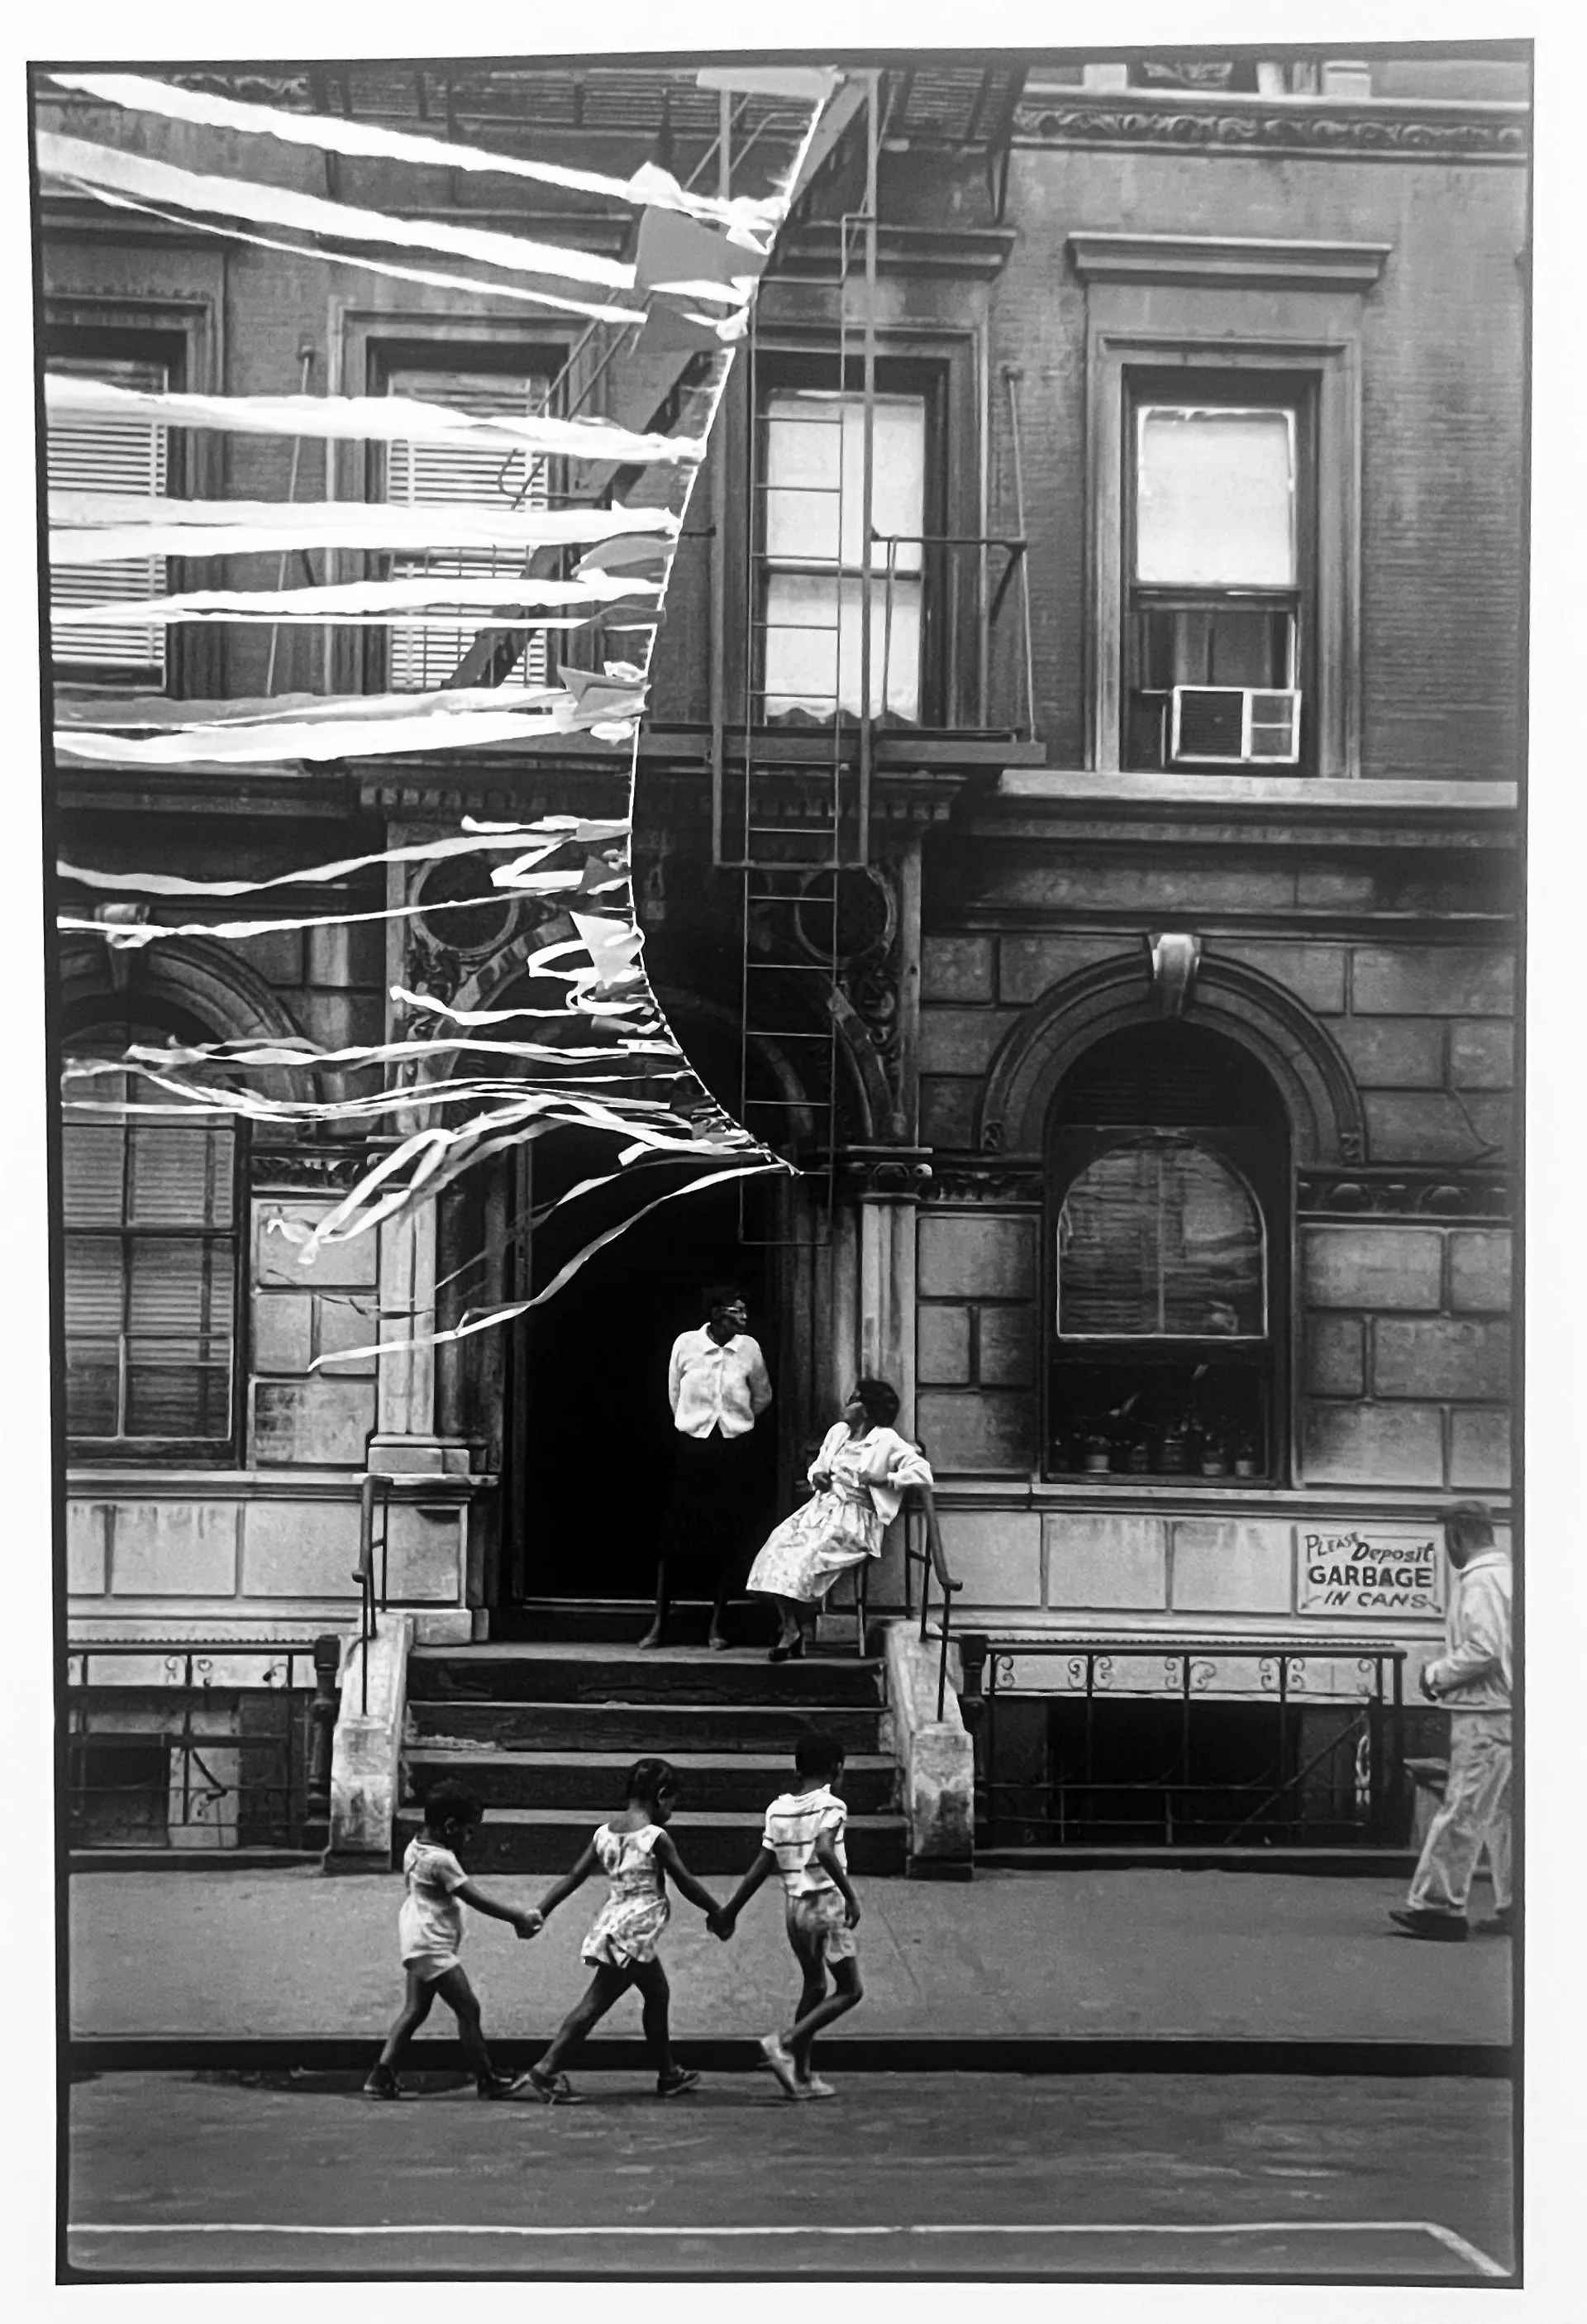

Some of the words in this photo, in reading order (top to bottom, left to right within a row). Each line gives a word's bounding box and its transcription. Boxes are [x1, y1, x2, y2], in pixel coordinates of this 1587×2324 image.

[1351, 1542, 1435, 1564] Deposit
[1308, 1565, 1432, 1587] GARBAGE
[1324, 1590, 1351, 1606] IN
[1357, 1592, 1428, 1609] CANS
